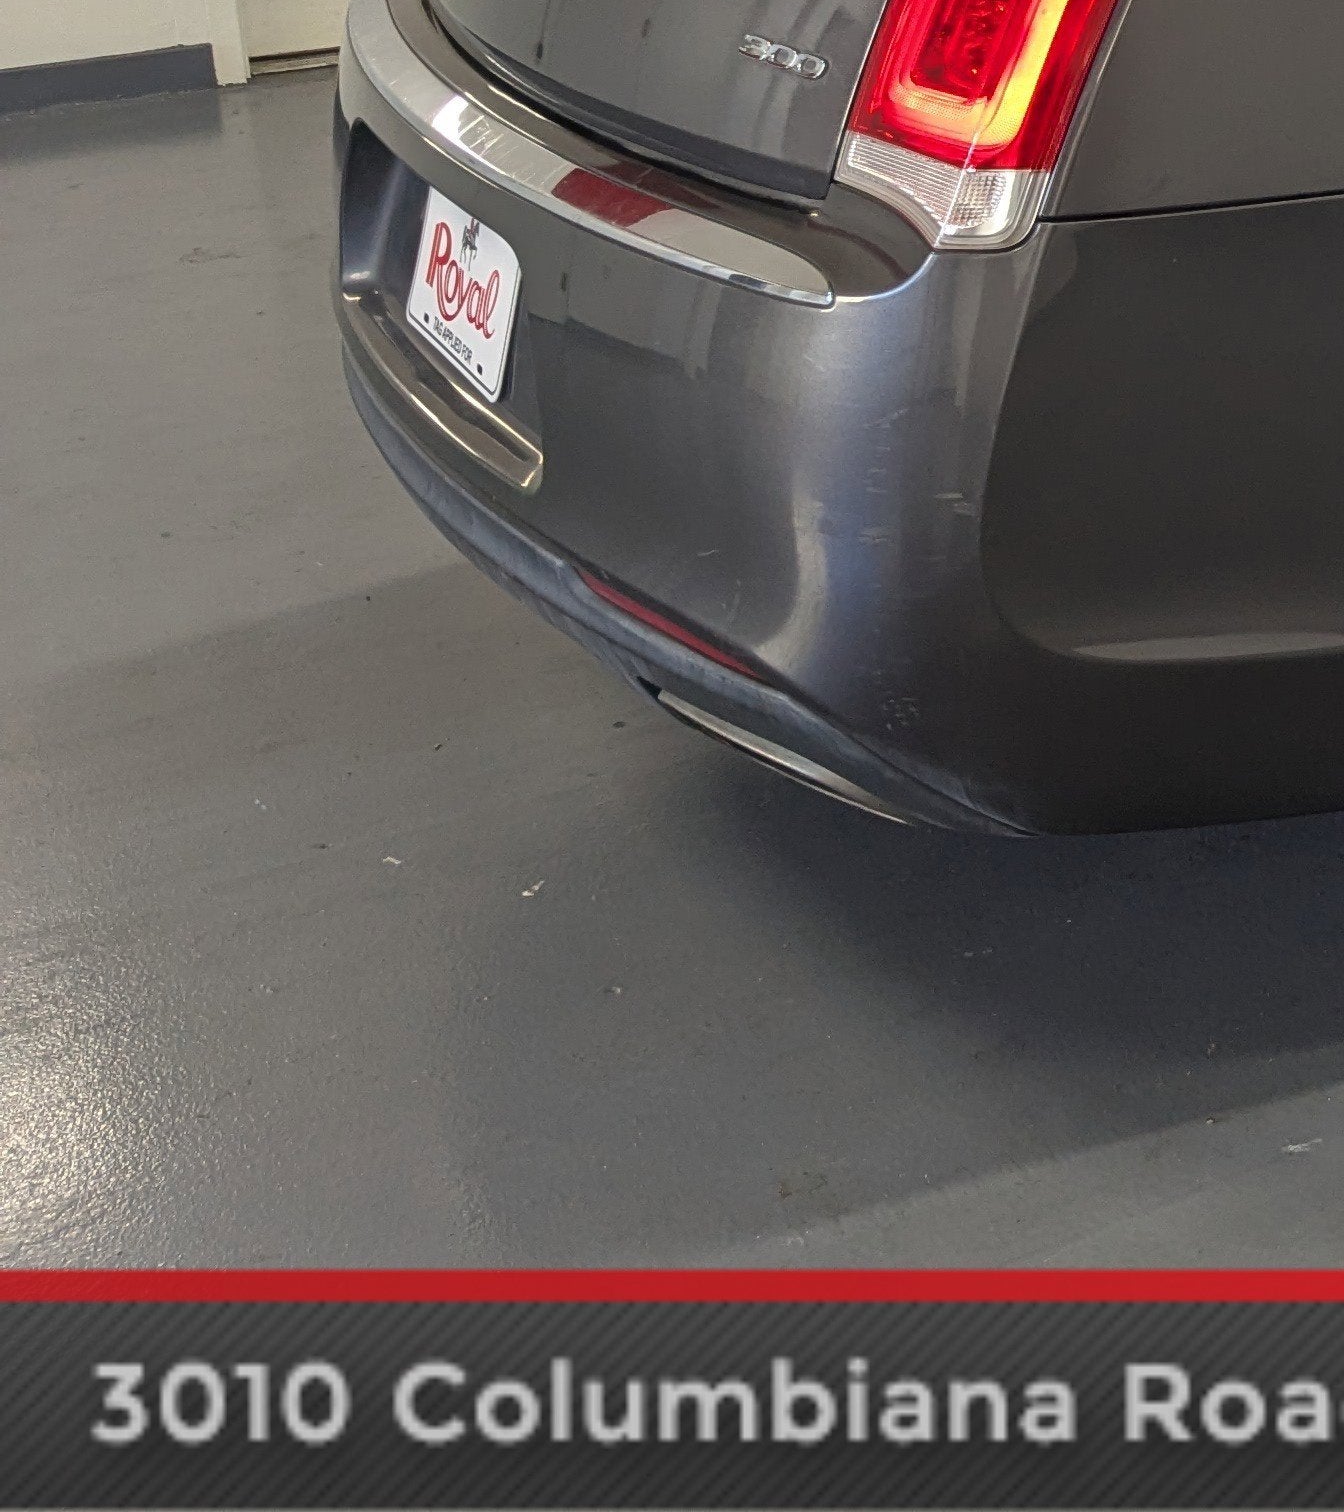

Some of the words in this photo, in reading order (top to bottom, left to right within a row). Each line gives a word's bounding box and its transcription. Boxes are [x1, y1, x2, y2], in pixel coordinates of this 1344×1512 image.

[739, 34, 827, 80] 300
[425, 220, 500, 340] Royal
[433, 315, 444, 337] TAG
[442, 326, 462, 354] APPLIED
[461, 343, 473, 366] FOR
